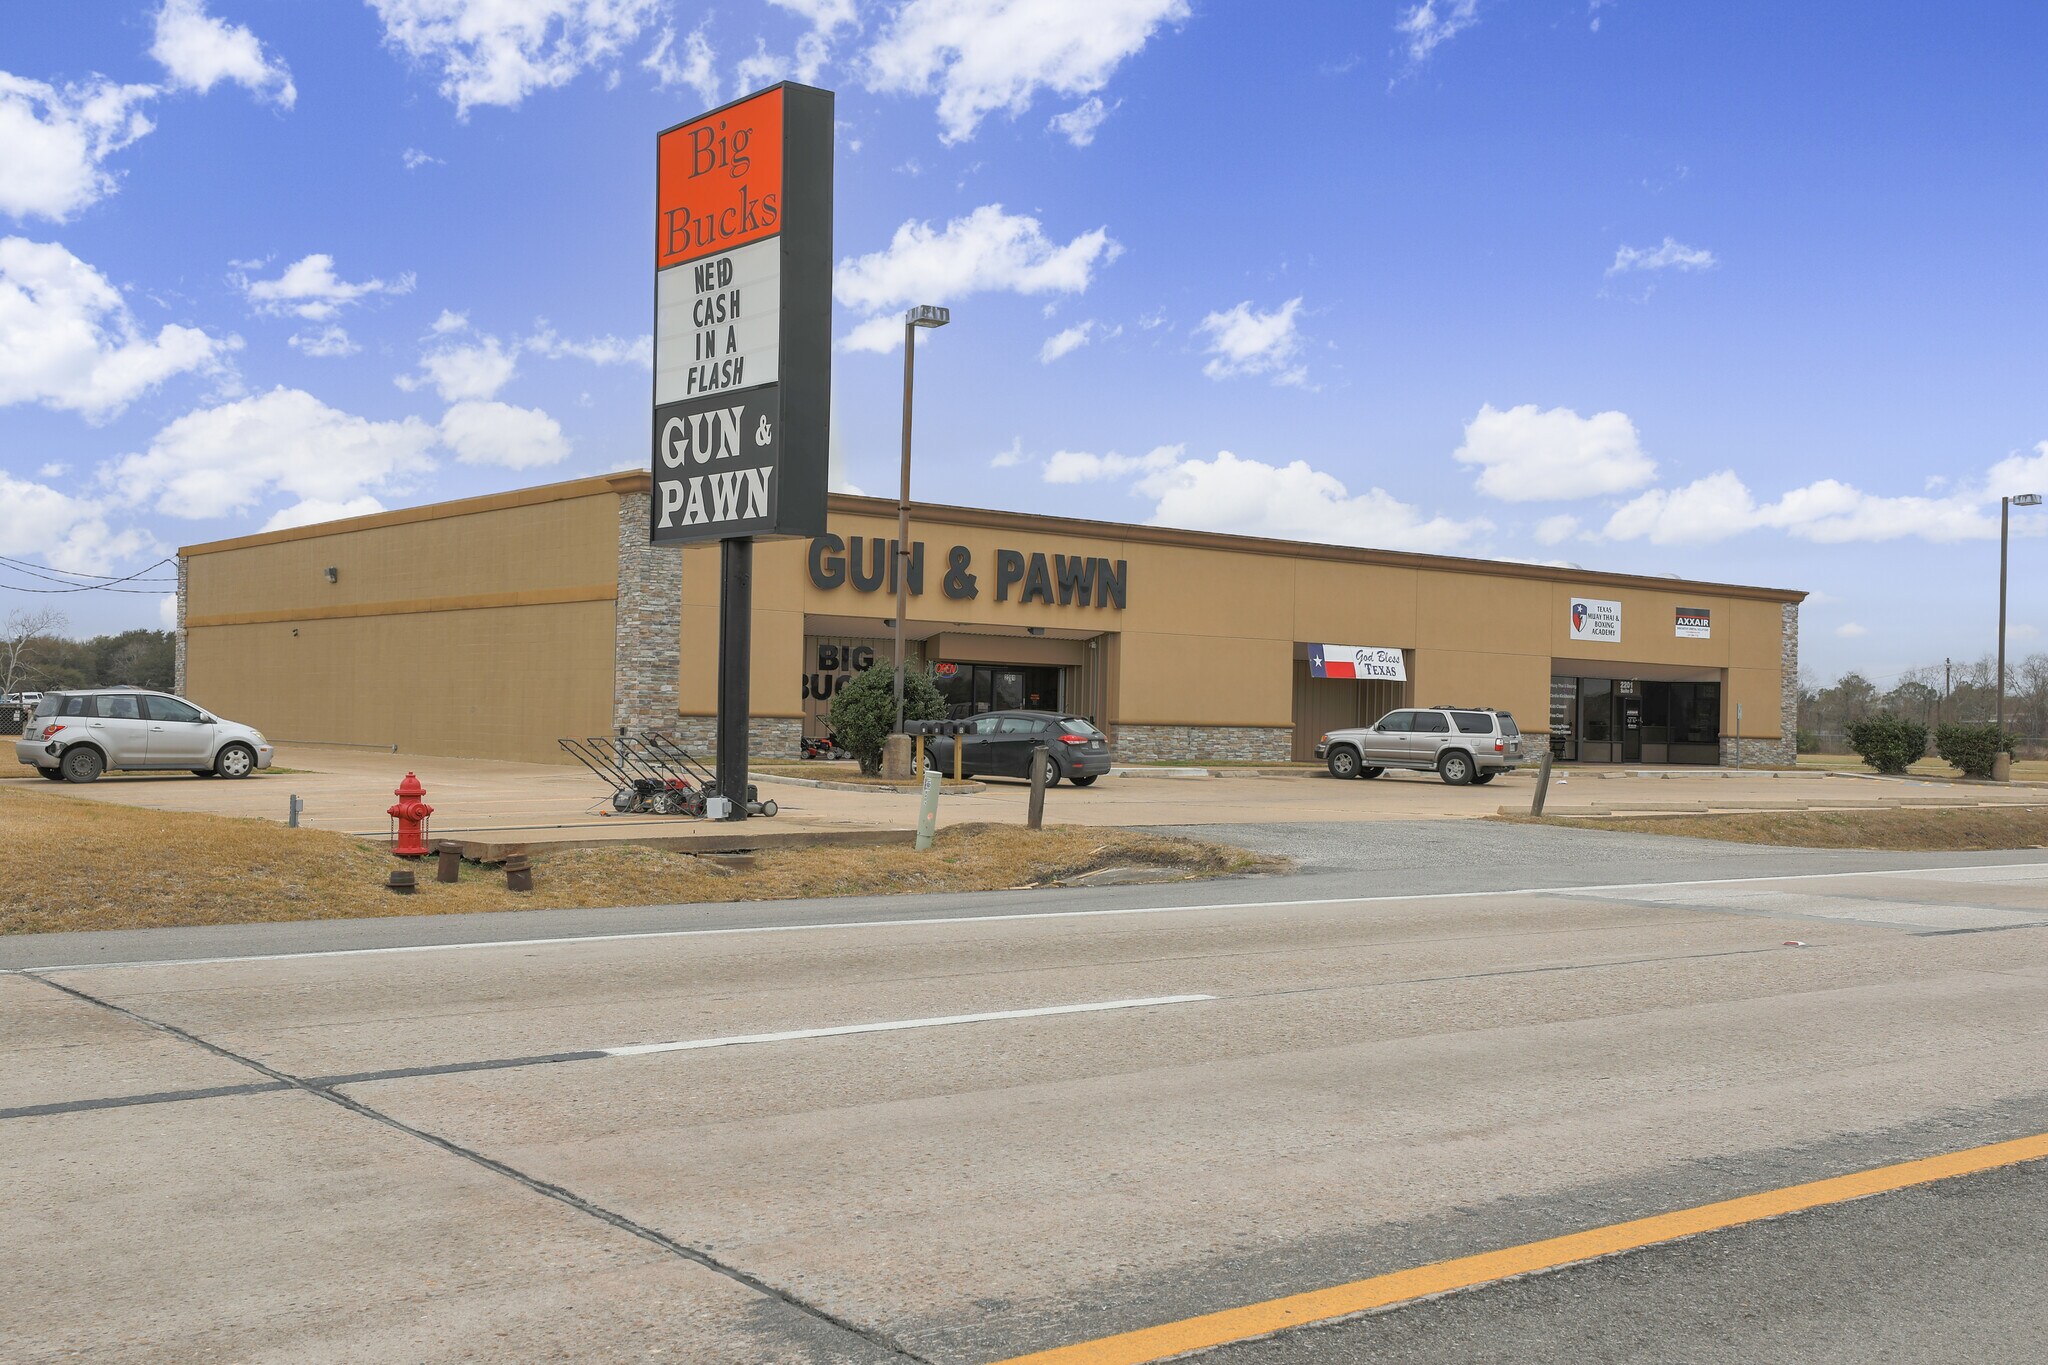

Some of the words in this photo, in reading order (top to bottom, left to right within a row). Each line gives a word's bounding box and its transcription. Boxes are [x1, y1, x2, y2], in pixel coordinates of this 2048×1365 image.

[688, 120, 753, 178] Big
[664, 184, 778, 257] Bucks
[693, 289, 740, 328] CASH
[695, 329, 716, 361] IN
[726, 325, 737, 354] A
[686, 356, 744, 395] FLASH
[660, 405, 745, 469] GUN
[755, 414, 772, 447] &
[657, 465, 774, 529] PAWN
[808, 532, 925, 596] GUN
[942, 545, 979, 600] &
[994, 548, 1127, 609] PAWN
[1677, 617, 1709, 627] AXXAIR
[818, 644, 874, 672] BIG
[1355, 649, 1374, 665] God
[1377, 650, 1400, 664] Bless
[1364, 663, 1397, 677] TEXAS
